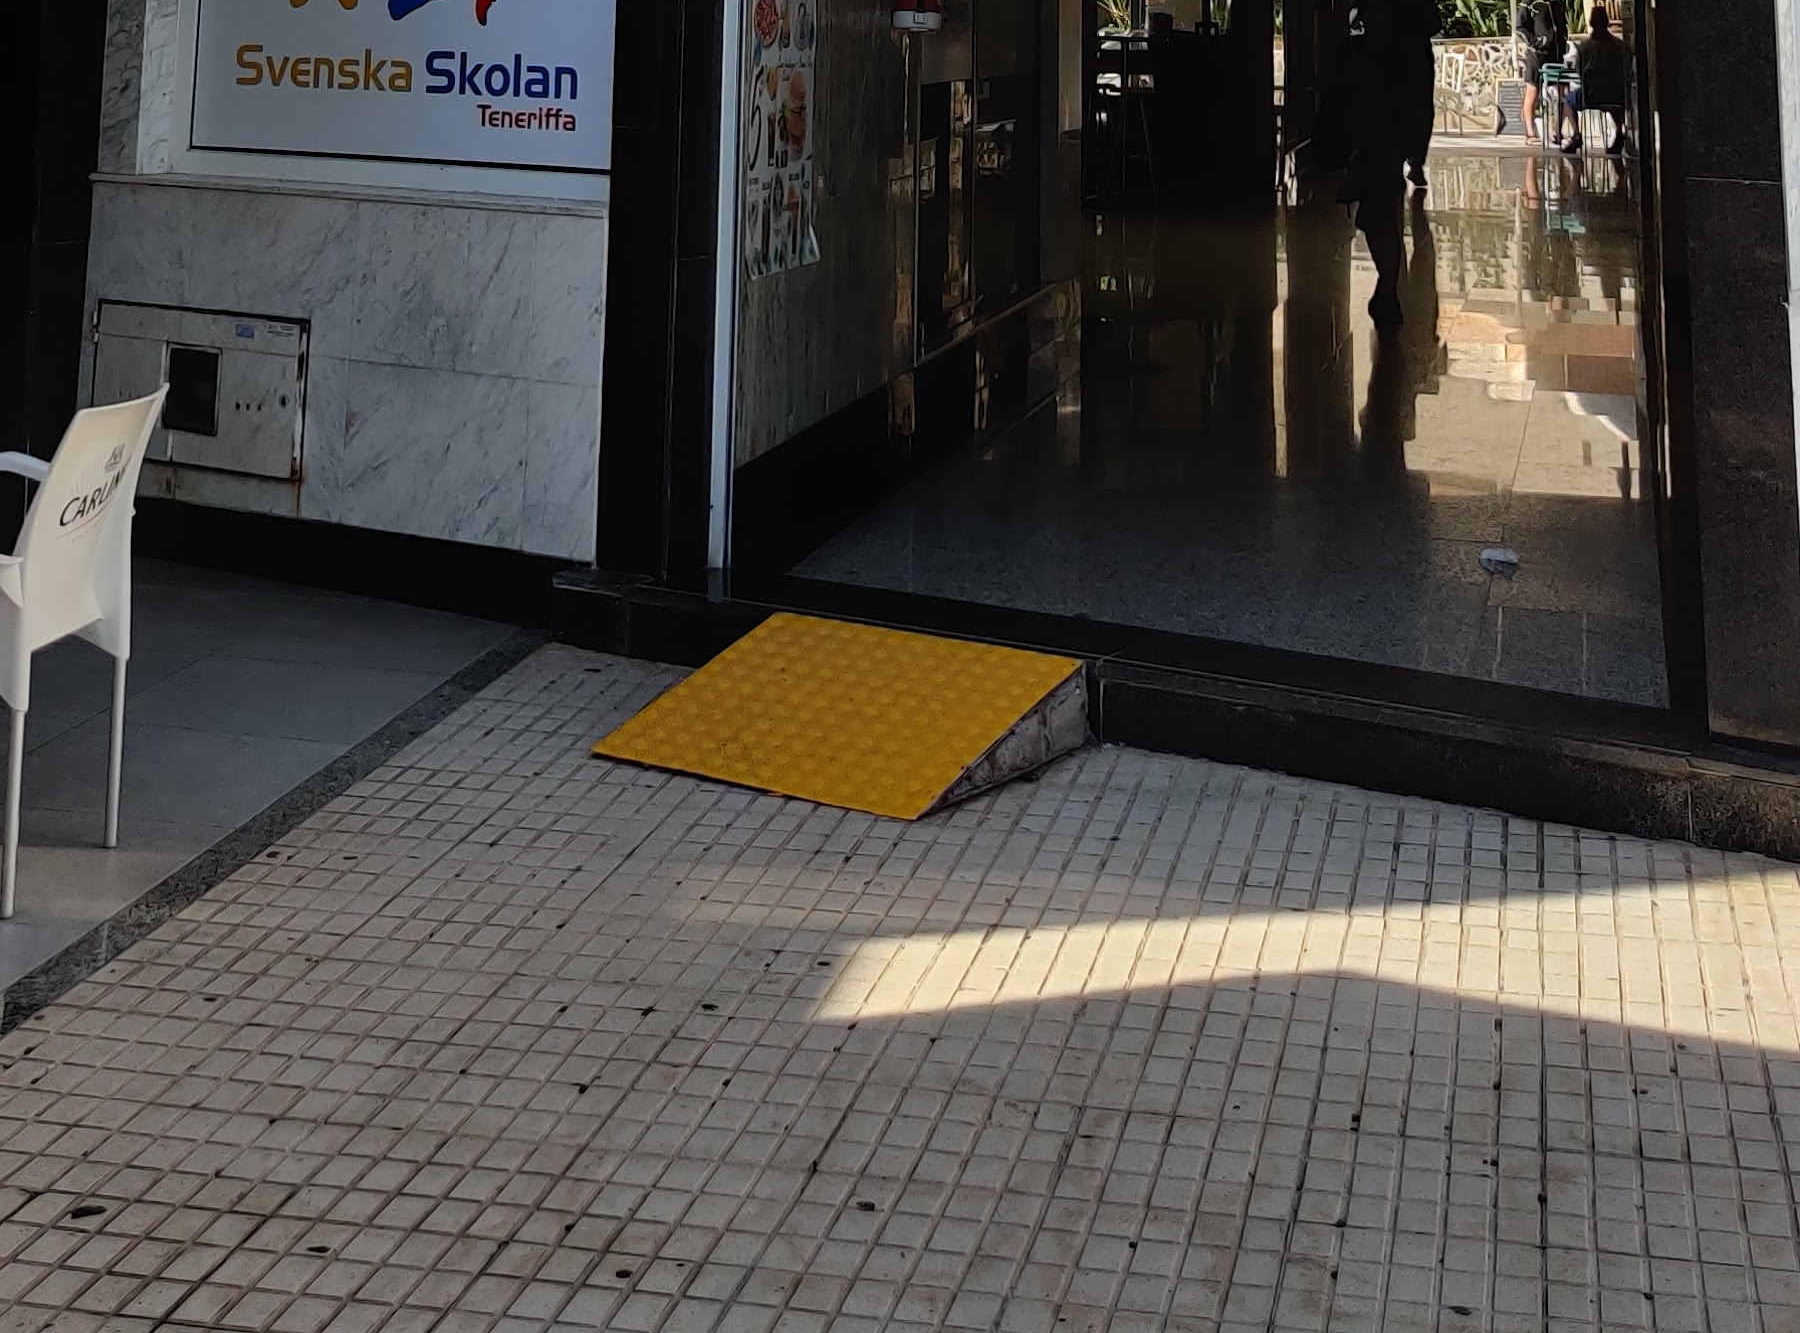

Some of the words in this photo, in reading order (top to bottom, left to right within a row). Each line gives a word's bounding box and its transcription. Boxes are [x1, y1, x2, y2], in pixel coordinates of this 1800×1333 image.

[235, 43, 413, 93] Svenska
[425, 50, 578, 100] Skolan
[476, 104, 577, 132] Teneriffa
